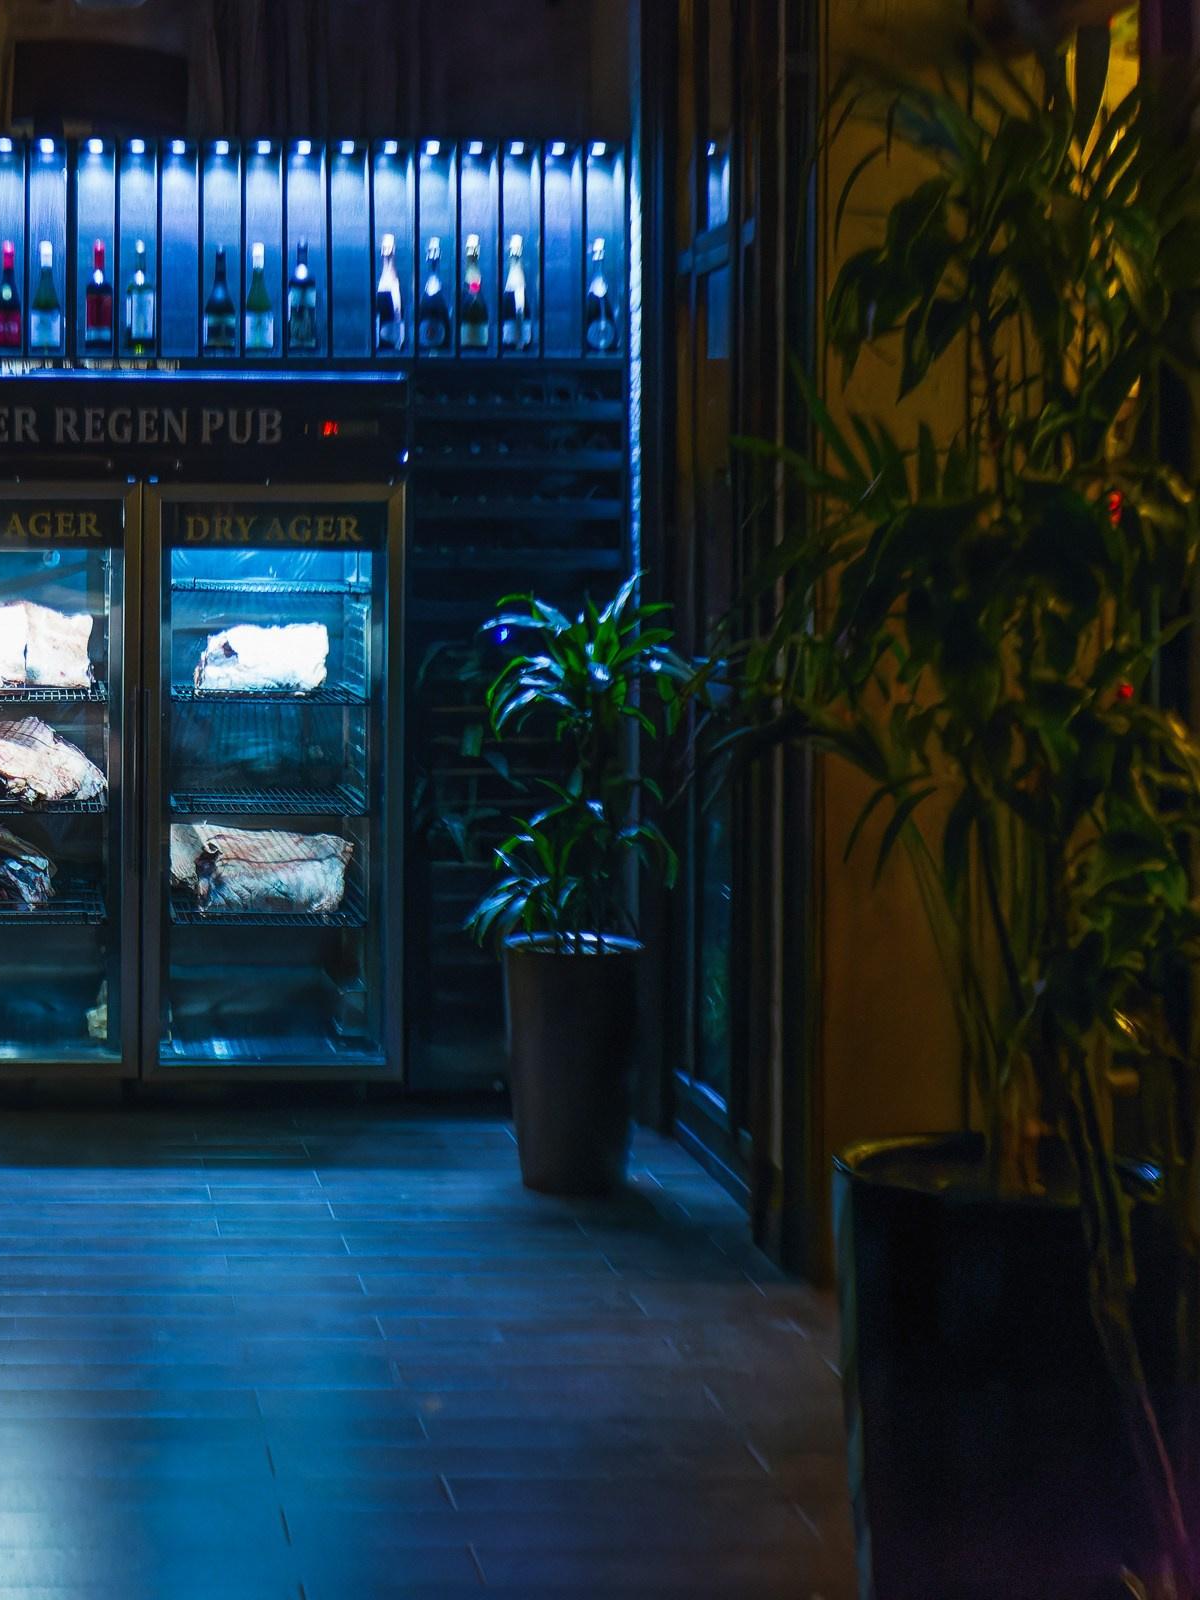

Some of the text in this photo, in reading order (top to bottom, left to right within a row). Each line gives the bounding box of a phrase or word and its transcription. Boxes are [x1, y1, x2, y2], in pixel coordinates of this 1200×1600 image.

[55, 407, 188, 444] REGEN
[201, 408, 282, 445] PUB
[4, 511, 102, 540] AGER
[185, 514, 363, 543] DRY AGER
